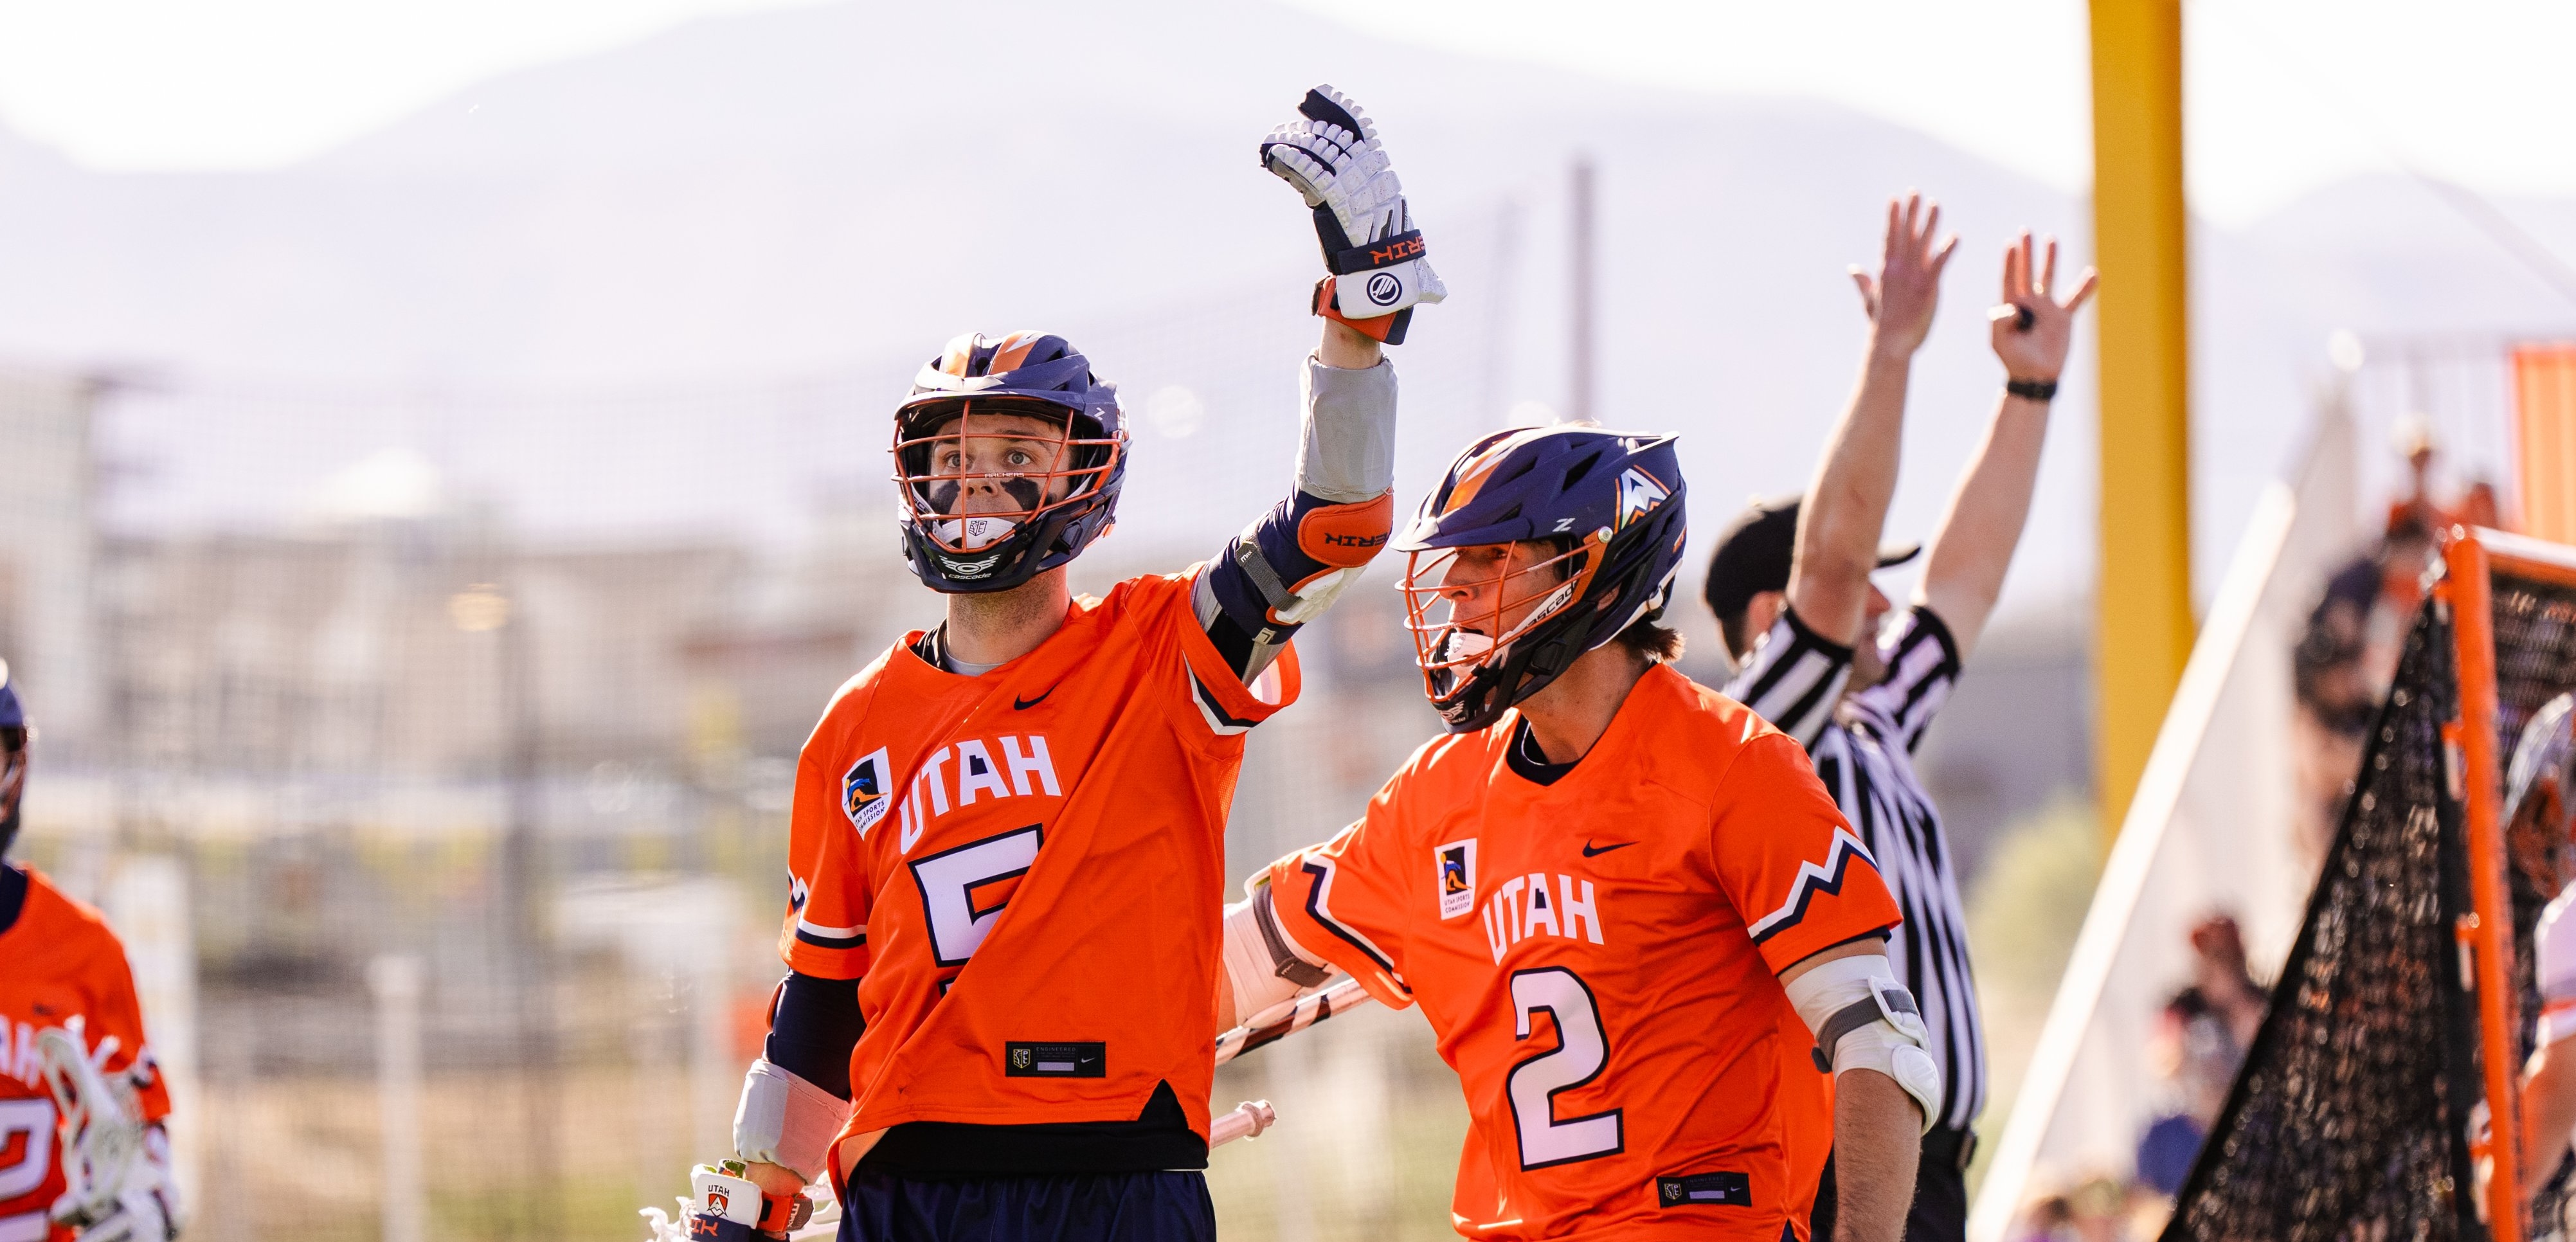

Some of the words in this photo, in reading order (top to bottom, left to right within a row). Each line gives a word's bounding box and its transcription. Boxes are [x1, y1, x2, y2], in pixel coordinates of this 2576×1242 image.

[863, 800, 885, 818] SPORTS
[899, 735, 1063, 855] UTAH
[907, 822, 1045, 998] 5
[1482, 872, 1605, 967] UTAH
[1506, 966, 1625, 1173] 2
[708, 1184, 730, 1197] UTAH
